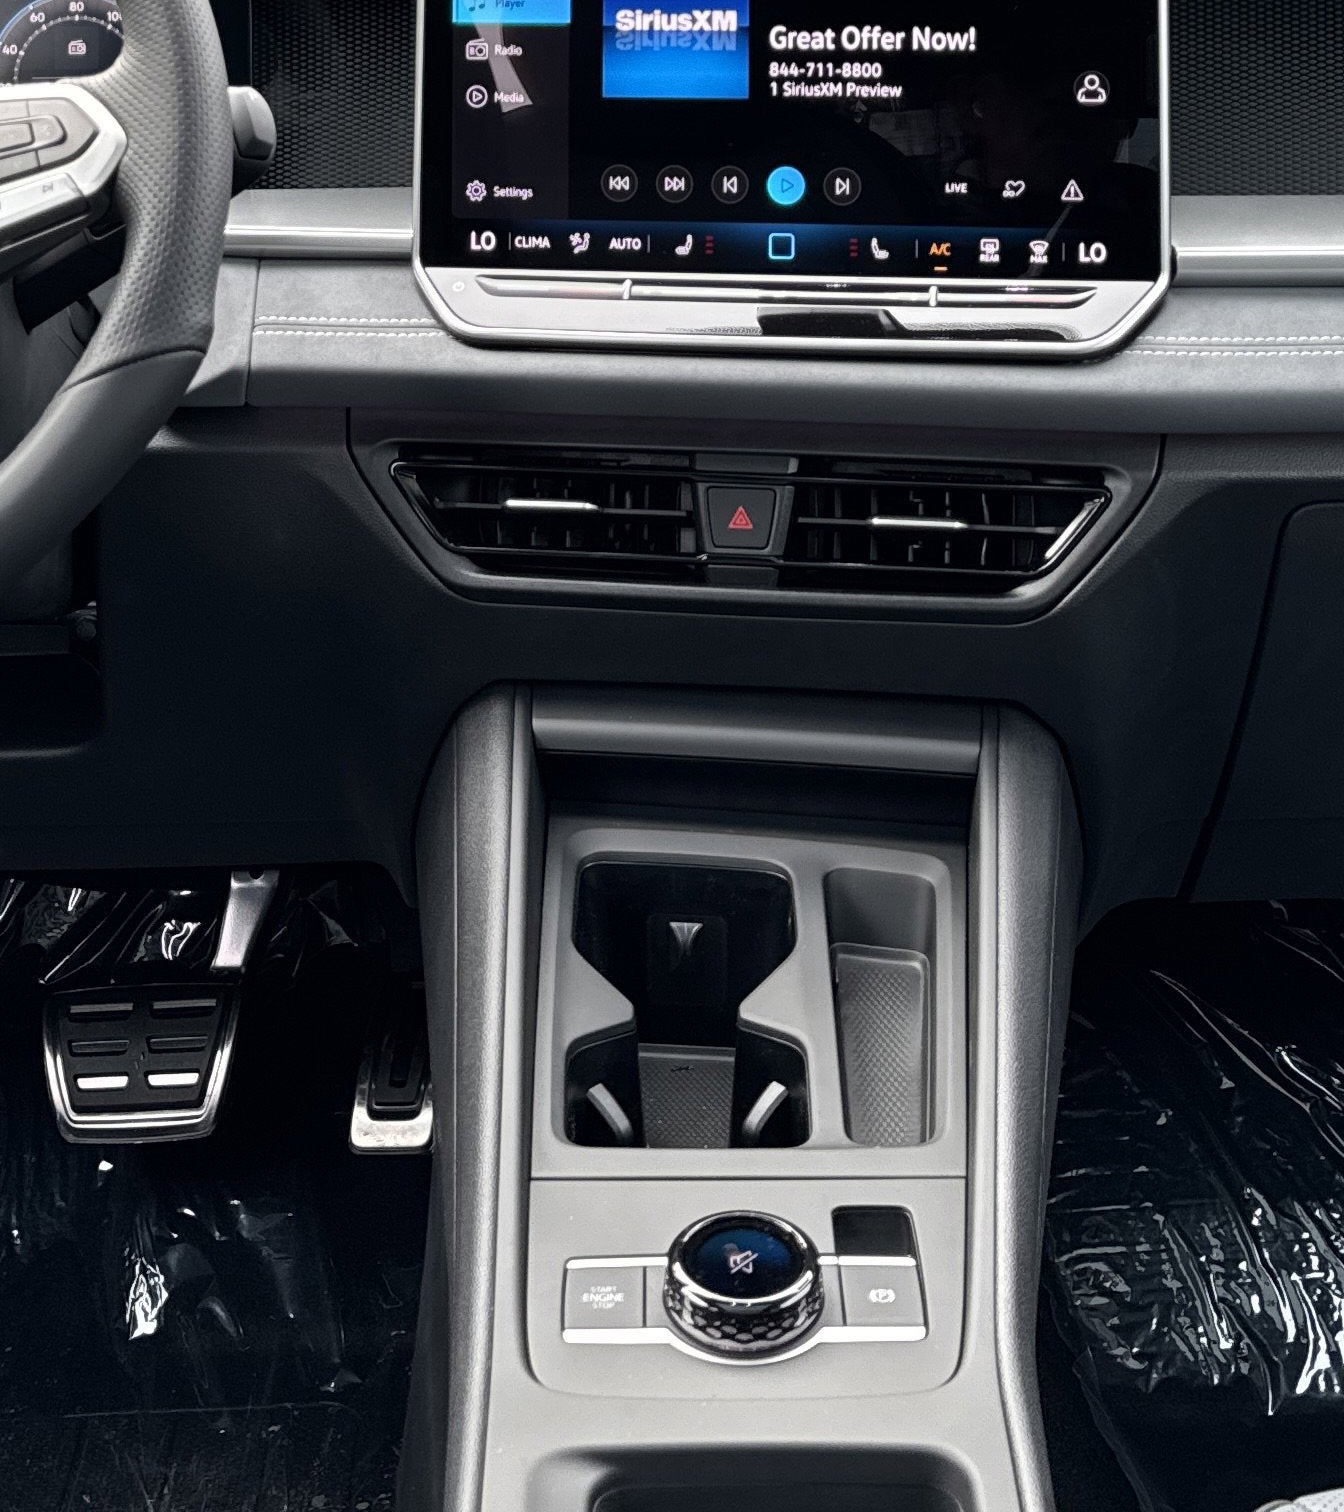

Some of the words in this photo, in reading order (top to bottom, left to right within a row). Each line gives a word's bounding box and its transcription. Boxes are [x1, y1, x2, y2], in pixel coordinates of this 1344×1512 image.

[68, 0, 85, 13] 80
[29, 11, 46, 24] 60
[614, 9, 739, 33] SiriusXM
[769, 24, 836, 52] Great
[840, 24, 906, 52] Offer
[911, 24, 978, 52] Now!
[1, 43, 19, 56] 40
[494, 43, 523, 57] Radio
[768, 61, 883, 79] 844-711-8800
[494, 90, 525, 104] Media
[770, 81, 778, 97] 1
[782, 81, 842, 98] SiriusXM
[846, 81, 904, 98] Preview
[492, 186, 534, 201] Settings
[944, 181, 969, 194] LIVE
[469, 229, 497, 251] LO
[513, 235, 552, 250] CLIMA
[607, 236, 642, 251] AUTO
[928, 242, 953, 257] A/C
[1078, 241, 1107, 264] LO
[590, 1285, 618, 1294] START
[582, 1292, 625, 1304] ENGINE
[592, 1301, 616, 1310] STOP
